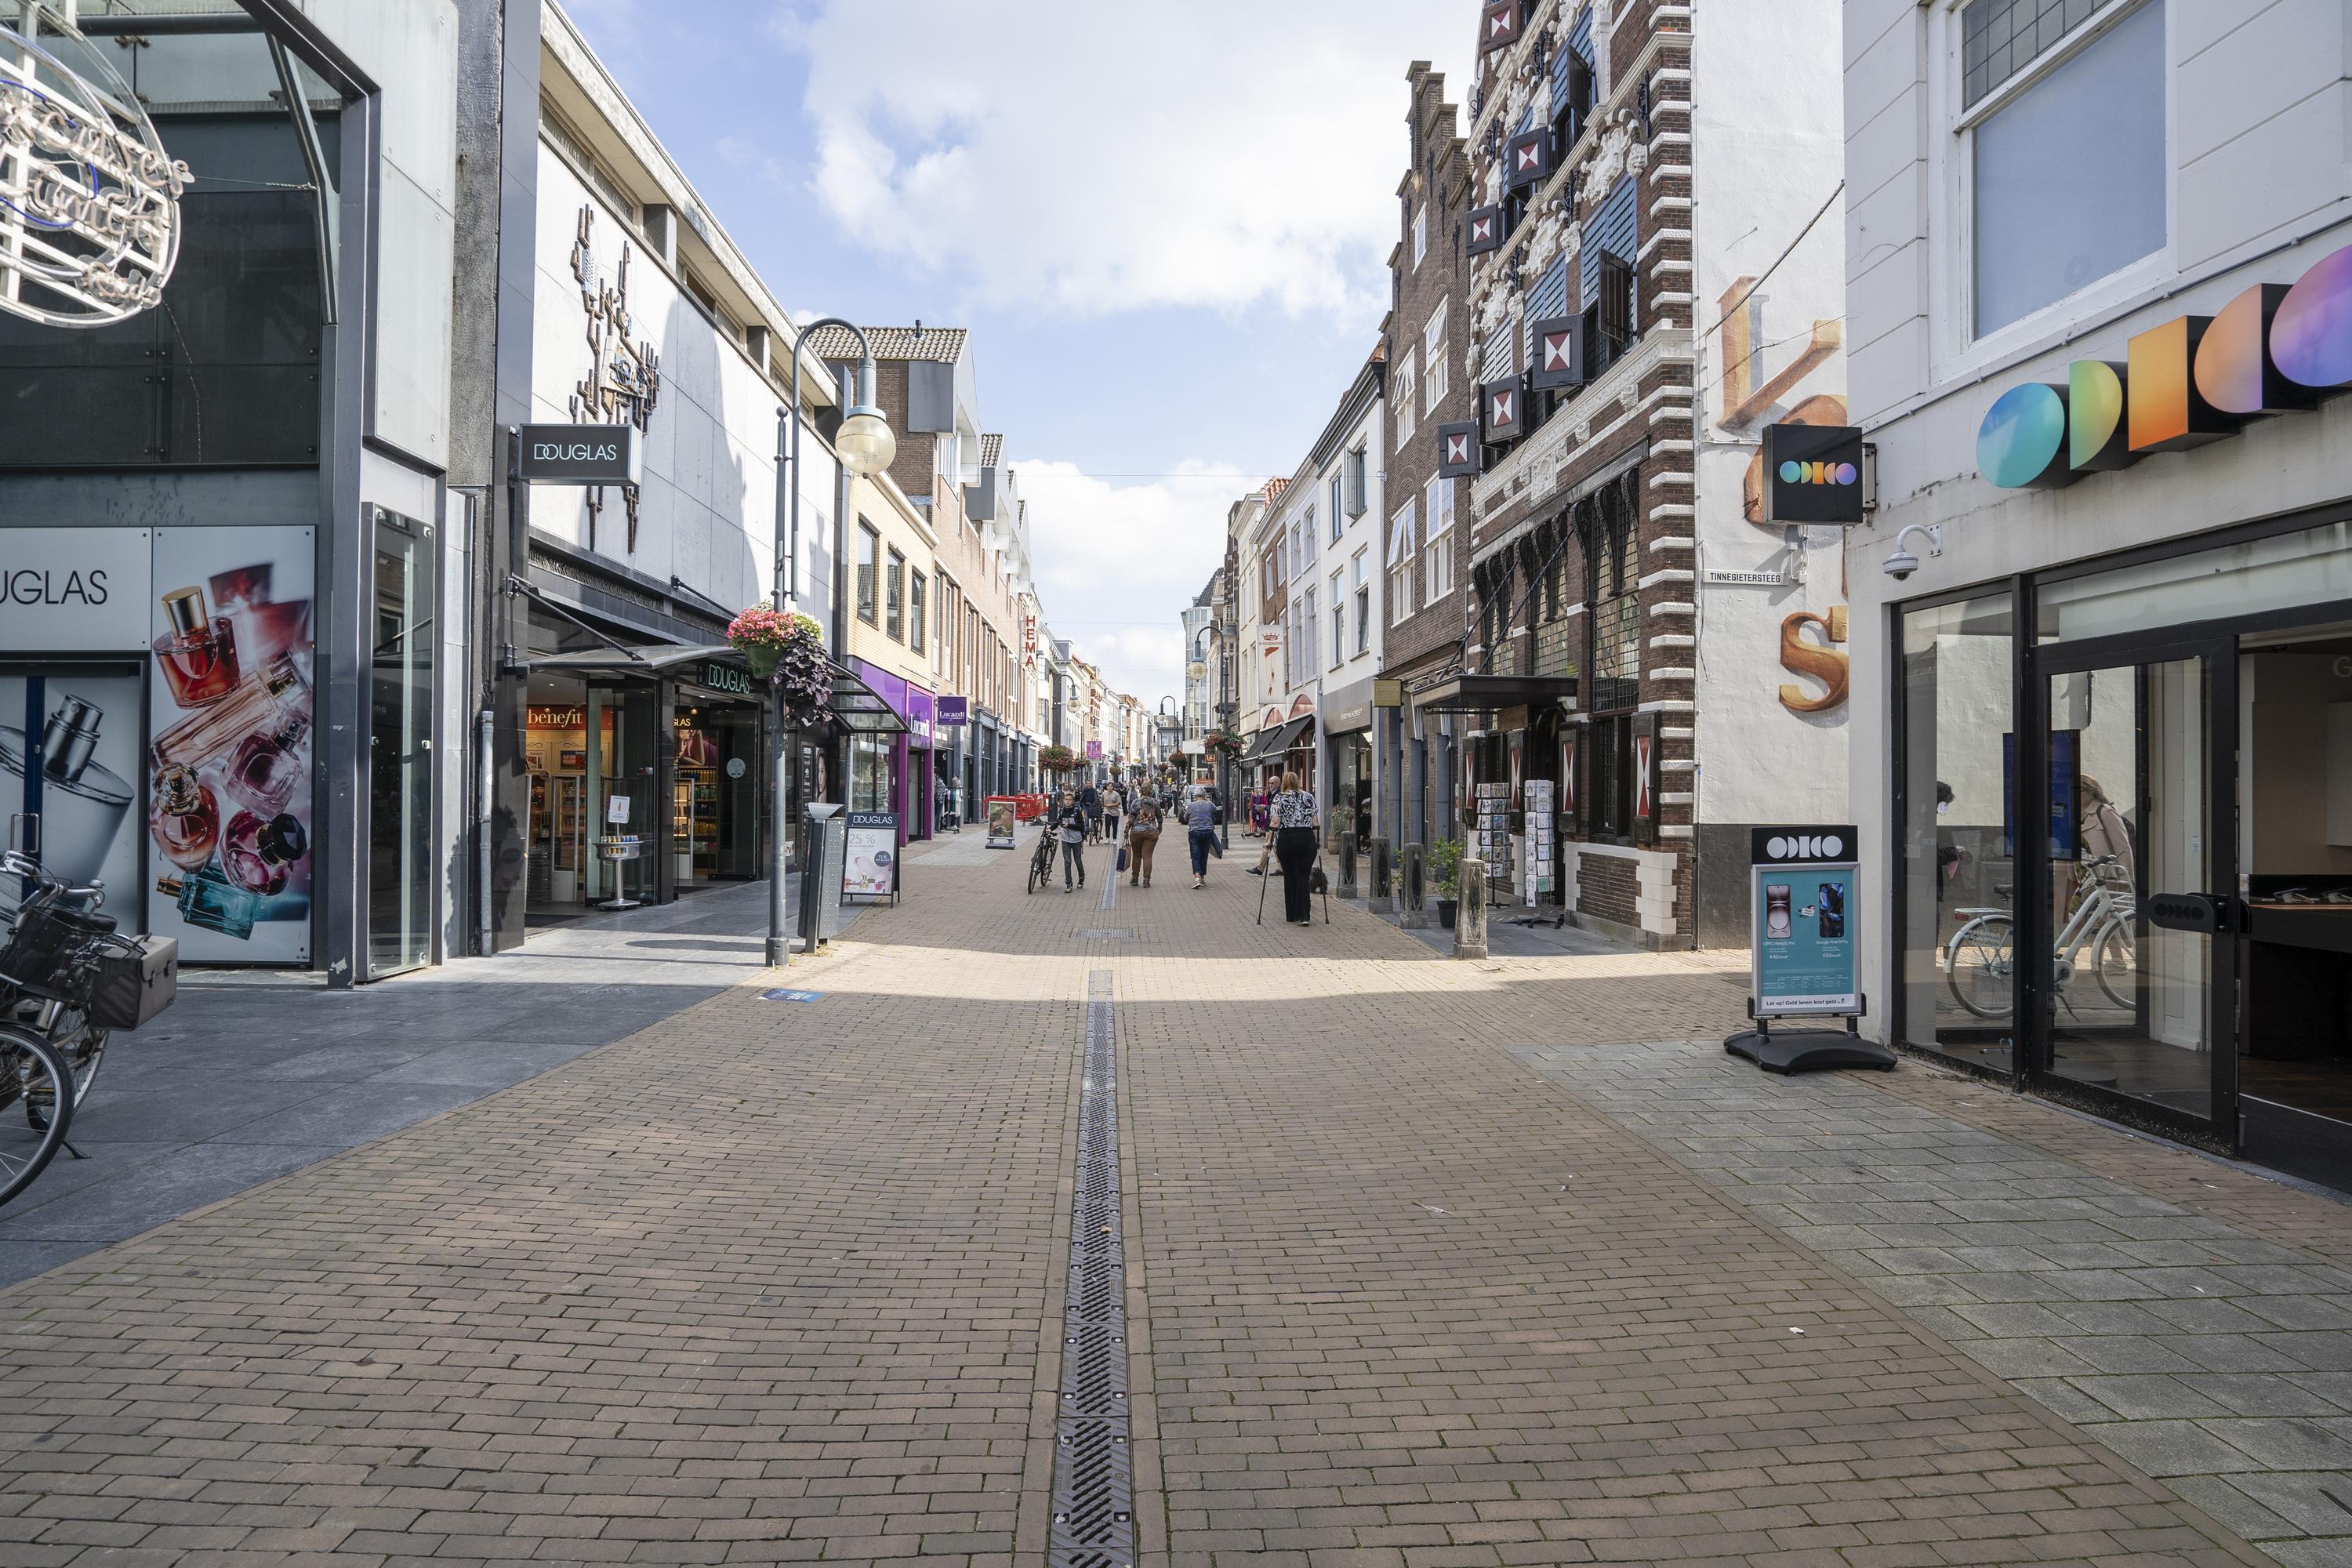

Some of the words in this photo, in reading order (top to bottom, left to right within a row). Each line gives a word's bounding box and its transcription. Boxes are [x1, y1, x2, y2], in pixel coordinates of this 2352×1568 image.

[533, 443, 618, 461] DOUGLAS
[1710, 572, 1781, 583] TINNEGIETERSTEEG
[1025, 615, 1036, 667] HEMA
[708, 663, 750, 695] DOUGLAS
[527, 708, 583, 728] benefit
[853, 815, 893, 824] DOUGLAS
[848, 833, 862, 844] 25
[866, 833, 876, 844] %
